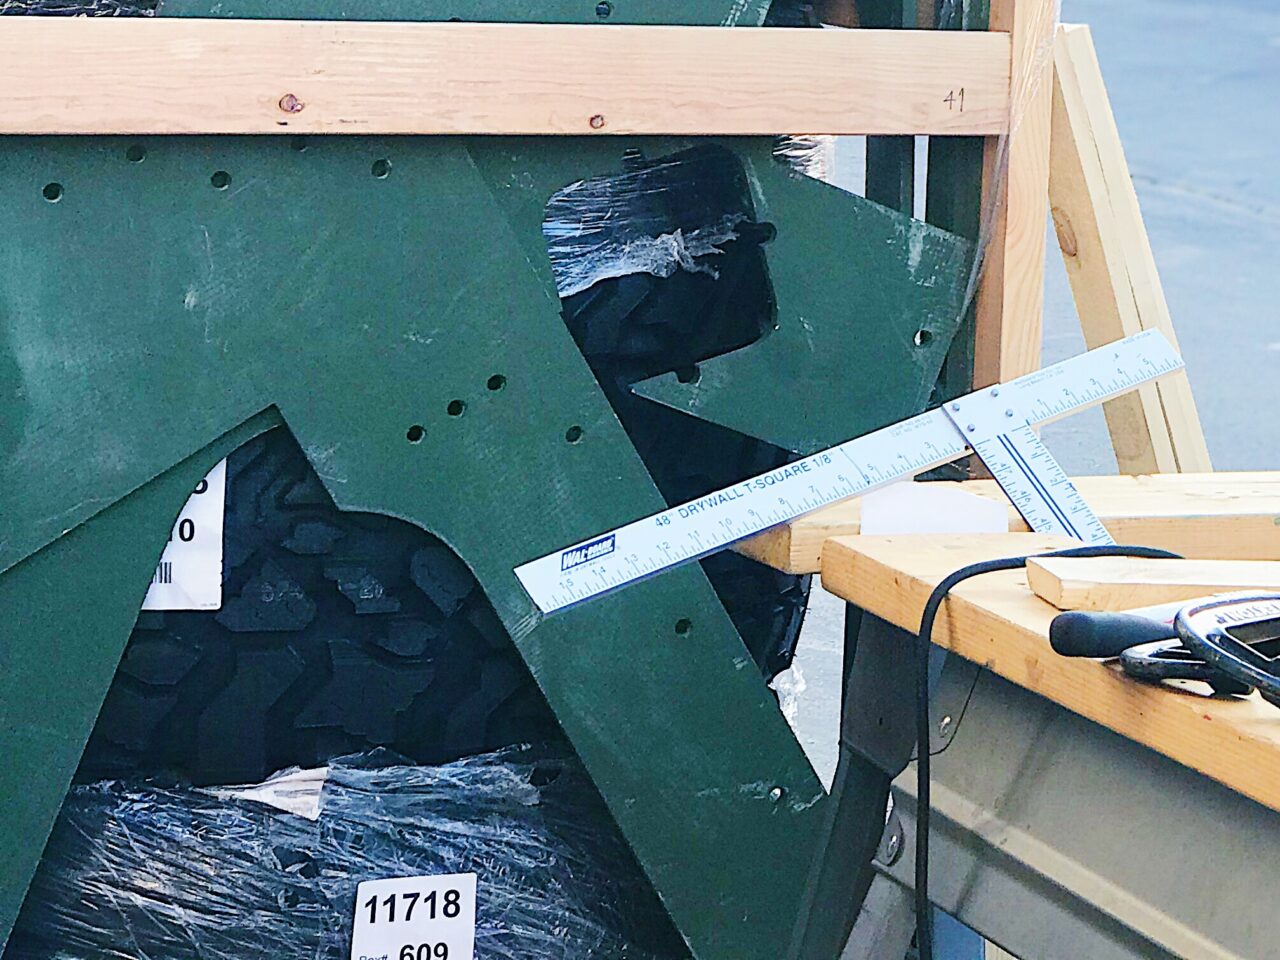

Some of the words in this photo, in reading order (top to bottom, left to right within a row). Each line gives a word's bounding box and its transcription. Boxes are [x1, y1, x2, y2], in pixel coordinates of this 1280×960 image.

[943, 87, 965, 112] 41
[678, 489, 744, 519] DRYWALL
[743, 461, 812, 494] T-SQUARE
[364, 889, 461, 923] 11718
